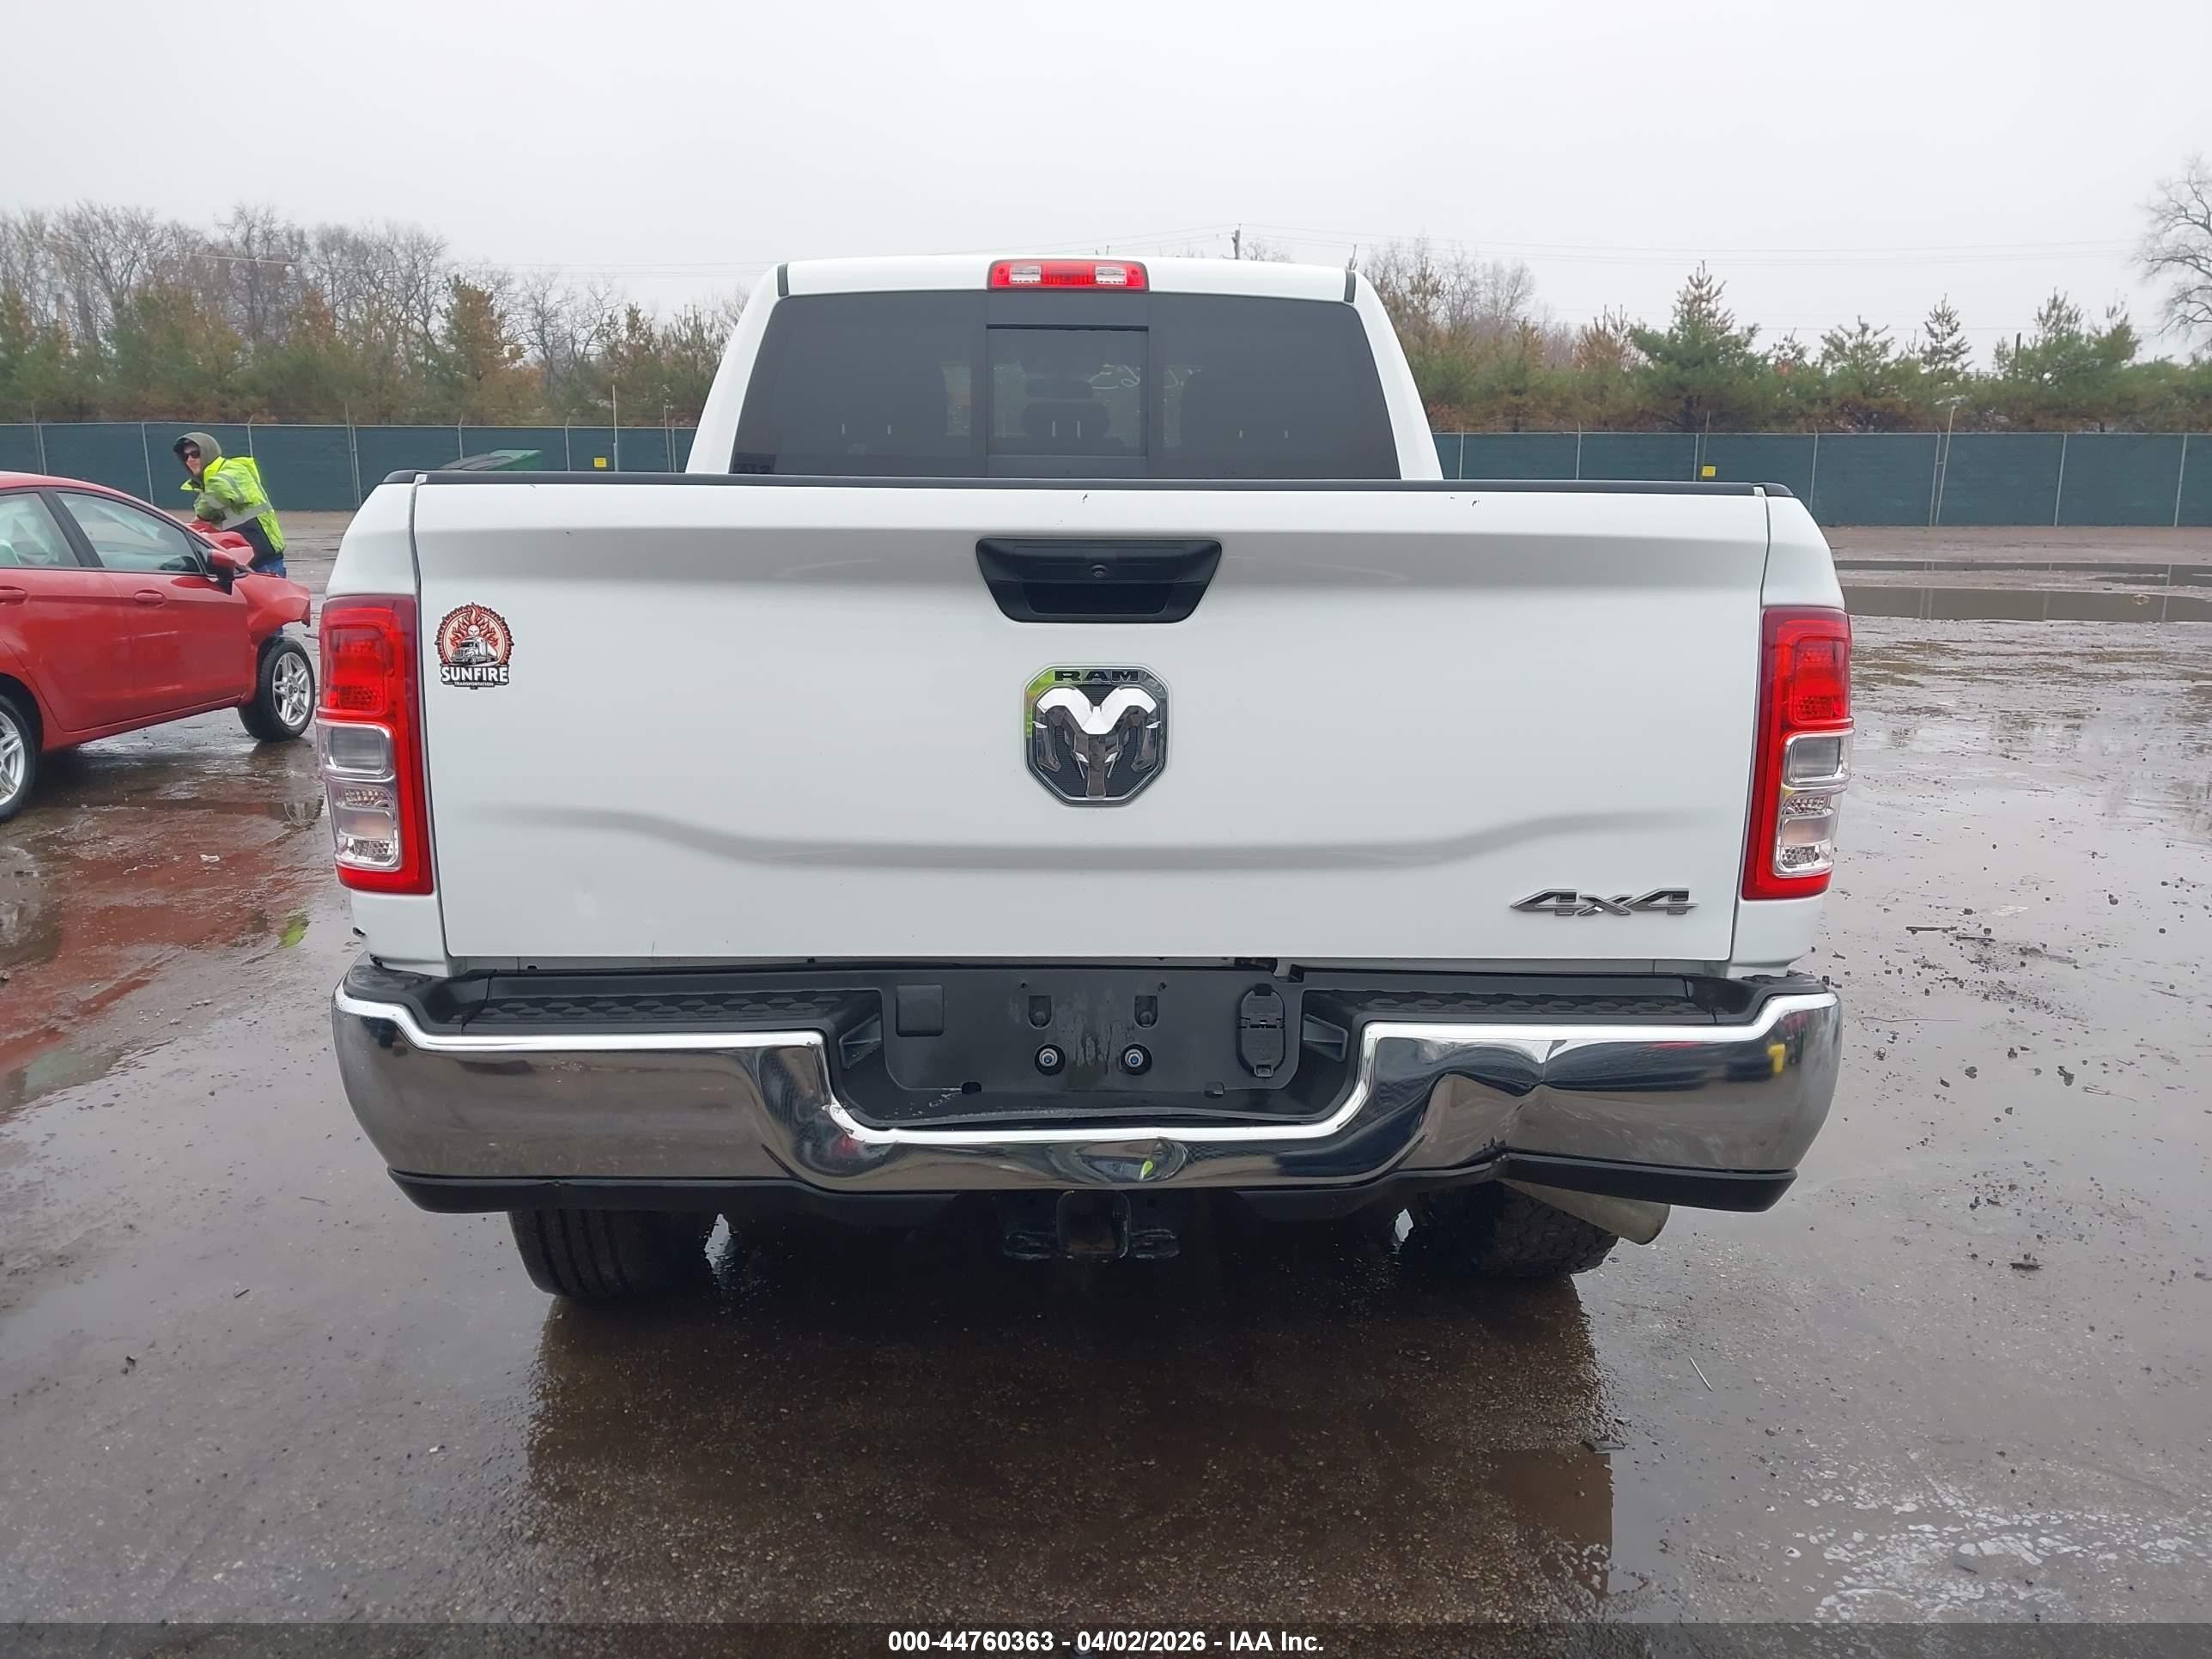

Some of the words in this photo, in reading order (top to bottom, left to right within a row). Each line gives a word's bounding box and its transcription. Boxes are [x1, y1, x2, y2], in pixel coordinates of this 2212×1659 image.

[441, 666, 508, 682] SUNFIRE
[1054, 671, 1139, 682] RAM
[1510, 888, 1698, 915] 4x4
